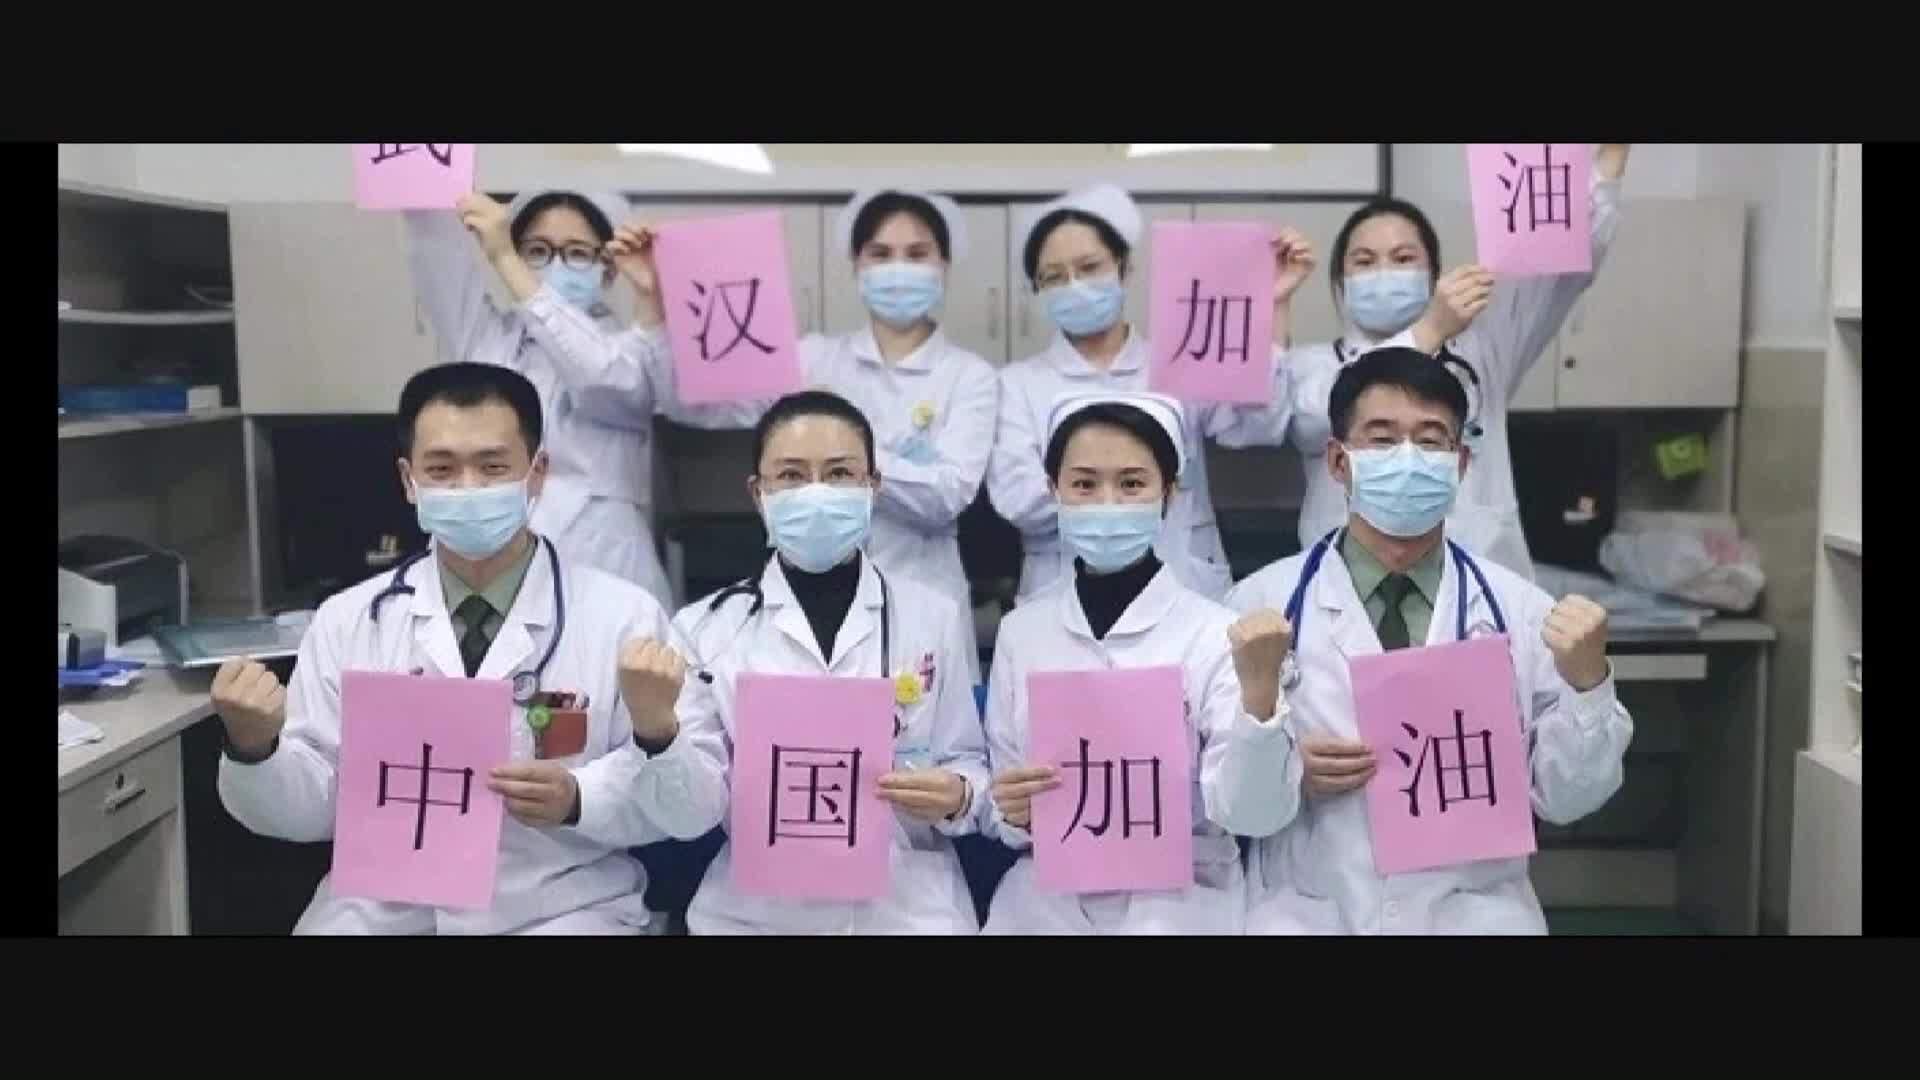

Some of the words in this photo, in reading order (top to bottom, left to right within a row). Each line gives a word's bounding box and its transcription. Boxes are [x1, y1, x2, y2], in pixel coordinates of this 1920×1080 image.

[1496, 144, 1571, 233] 油
[687, 278, 776, 361] 汉
[1171, 279, 1252, 364] 加
[377, 743, 474, 850] 中
[768, 743, 863, 848] 国
[1060, 737, 1162, 843] 加
[1393, 709, 1498, 818] 油
